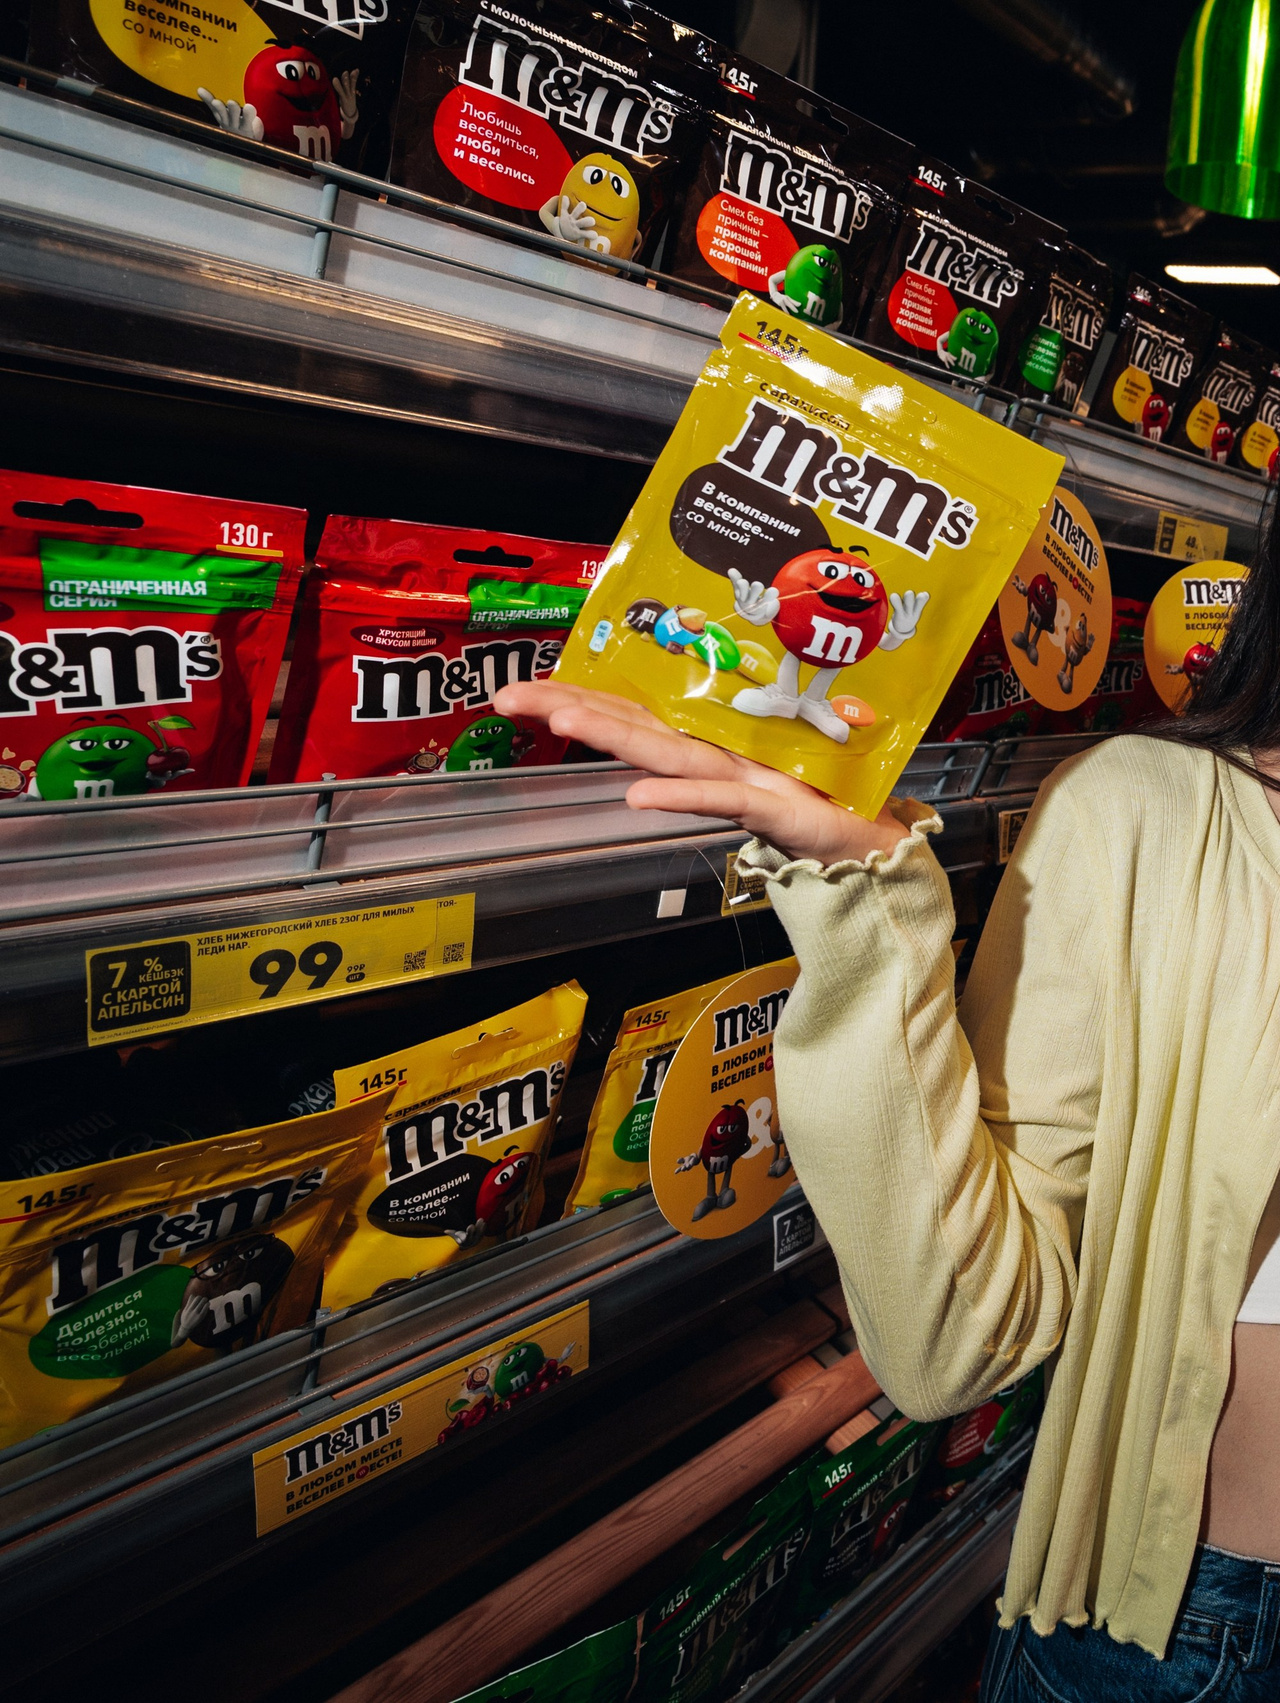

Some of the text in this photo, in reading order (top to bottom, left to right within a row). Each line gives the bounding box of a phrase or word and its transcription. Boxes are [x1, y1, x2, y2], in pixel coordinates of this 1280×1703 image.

[156, 0, 238, 32] мпании
[122, 19, 197, 54] со мной
[490, 5, 565, 45] молочным
[566, 39, 639, 78] шоколадом
[461, 102, 522, 136] Любишь
[456, 133, 501, 156] люби
[458, 118, 539, 159] веселиться,
[453, 147, 535, 185] и веселись
[917, 166, 947, 191] 145г
[718, 213, 760, 238] причины
[720, 199, 764, 227] Смех без
[712, 237, 761, 262] хорошей
[715, 225, 759, 249] признак
[709, 248, 768, 277] компании!
[906, 276, 936, 296] Смех без
[899, 307, 933, 326] хорошей
[901, 298, 931, 315] признак
[896, 317, 937, 338] компании!
[693, 496, 774, 542] веселее...
[701, 482, 801, 538] В компании
[686, 511, 752, 547] со мной
[1043, 545, 1068, 579] ВЕСЕЛЕЕ
[1045, 533, 1095, 593] В ЛЮБОМ МЕСТЕ
[50, 580, 207, 595] ОГРАНИЧЕННАЯ
[50, 594, 118, 608] СЕРИЯ
[472, 607, 569, 622] ОГРАНИЧЕННАЯ
[361, 634, 437, 648] СО ВКУСОМ ВИШНИ
[378, 628, 425, 639] ХРУСТЯЩИЙ
[802, 615, 863, 663] m
[0, 626, 223, 717] &m's
[197, 936, 223, 947] ХЛЕБ
[226, 920, 312, 942] НИЖЕГОРОДСКИЙ
[315, 916, 337, 928] ХЛЕБ
[362, 911, 381, 922] ДЛЯ
[383, 906, 415, 917] МИЛЫХ
[197, 941, 250, 957] ЛЕДИ НАР.
[108, 957, 163, 989] 7 %
[139, 968, 184, 983] КЕШБЭК
[250, 941, 343, 1000] 99
[103, 979, 181, 1005] С КАРТОЙ
[97, 994, 184, 1021] АПЕЛЬСИН
[636, 1010, 670, 1028] 145г
[712, 1065, 719, 1077] В
[722, 1046, 766, 1073] ЛЮБОМ
[359, 1068, 407, 1094] 145г
[711, 1068, 756, 1093] ВЕСЕЛЕЕ
[393, 1087, 461, 1119] арахисом
[17, 1183, 94, 1213] 145г
[389, 1193, 459, 1216] веселее...
[390, 1172, 470, 1208] В компании
[409, 1206, 446, 1222] мной
[56, 1289, 143, 1341] Делиться
[56, 1309, 140, 1349] полезно.
[56, 1328, 150, 1362] весельем!
[286, 1437, 402, 1502] В ЛЮБОМ МЕСТЕ
[825, 1462, 853, 1488] 145г
[287, 1478, 345, 1514] ВЕСЕЛЕЕ
[660, 1585, 691, 1620] 145г
[679, 1592, 722, 1638] солёный
